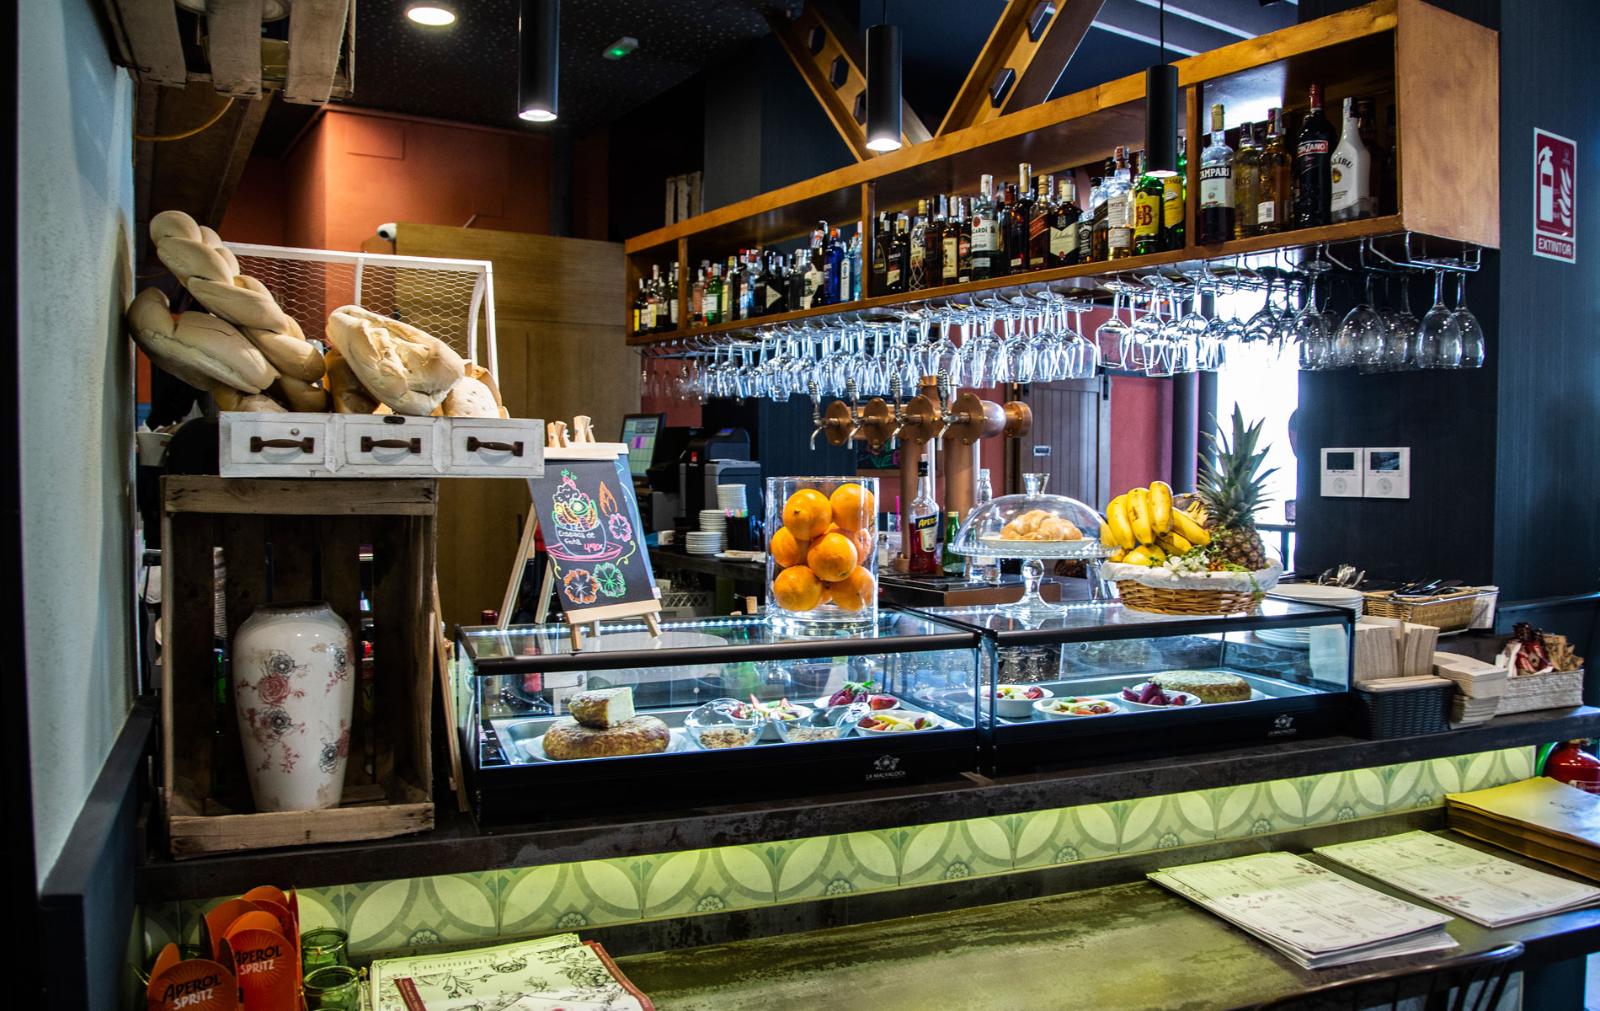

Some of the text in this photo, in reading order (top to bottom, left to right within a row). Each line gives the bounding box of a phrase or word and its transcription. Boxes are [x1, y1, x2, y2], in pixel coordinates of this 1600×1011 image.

[1538, 238, 1572, 256] EXTINTOR
[234, 946, 282, 965] APEROL
[240, 959, 275, 976] SPRITZ
[162, 974, 222, 1003] APEROL
[173, 988, 214, 1011] SPRITZ
